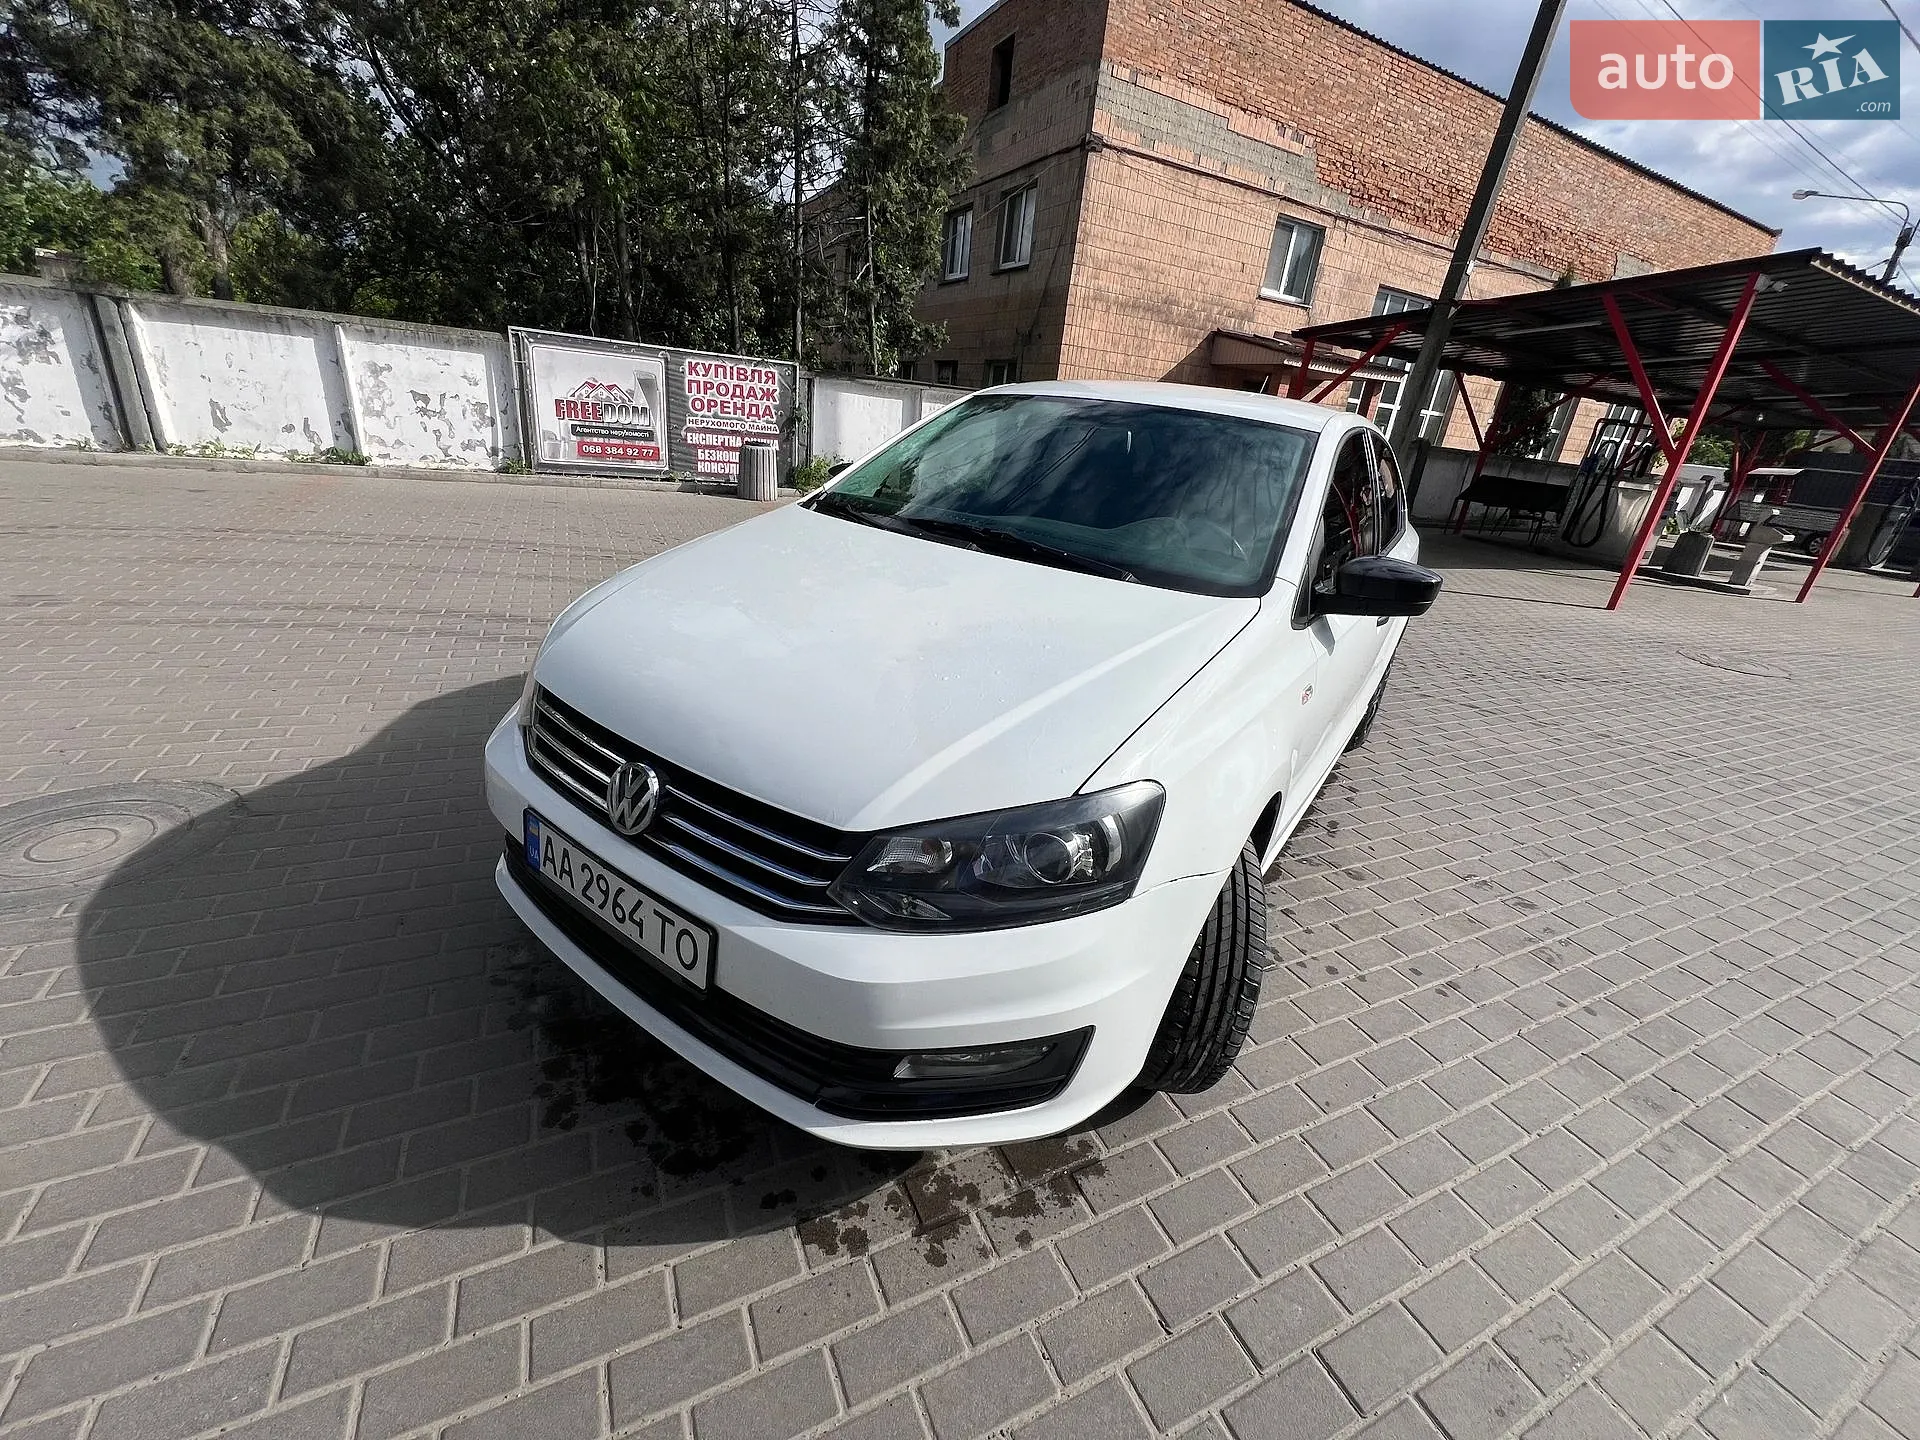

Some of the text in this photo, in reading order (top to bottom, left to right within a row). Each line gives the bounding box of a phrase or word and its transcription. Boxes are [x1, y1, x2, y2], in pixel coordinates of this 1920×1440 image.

[687, 361, 776, 385] КУПІВЛЯ
[687, 380, 778, 402] ПРОДАЖ
[555, 399, 651, 426] FREEDOM
[691, 398, 774, 420] ОРЕНДА
[576, 426, 649, 437] Агентство нерухомості
[688, 418, 778, 433] НЕРУХОМОГО МАЙНА
[686, 432, 743, 448] ЕКСПЕРТНА
[582, 445, 654, 457] 068 384 92 77
[697, 449, 740, 463] БЕЗКОШ
[529, 845, 540, 861] UA
[543, 835, 699, 971] AA 2964 TO
